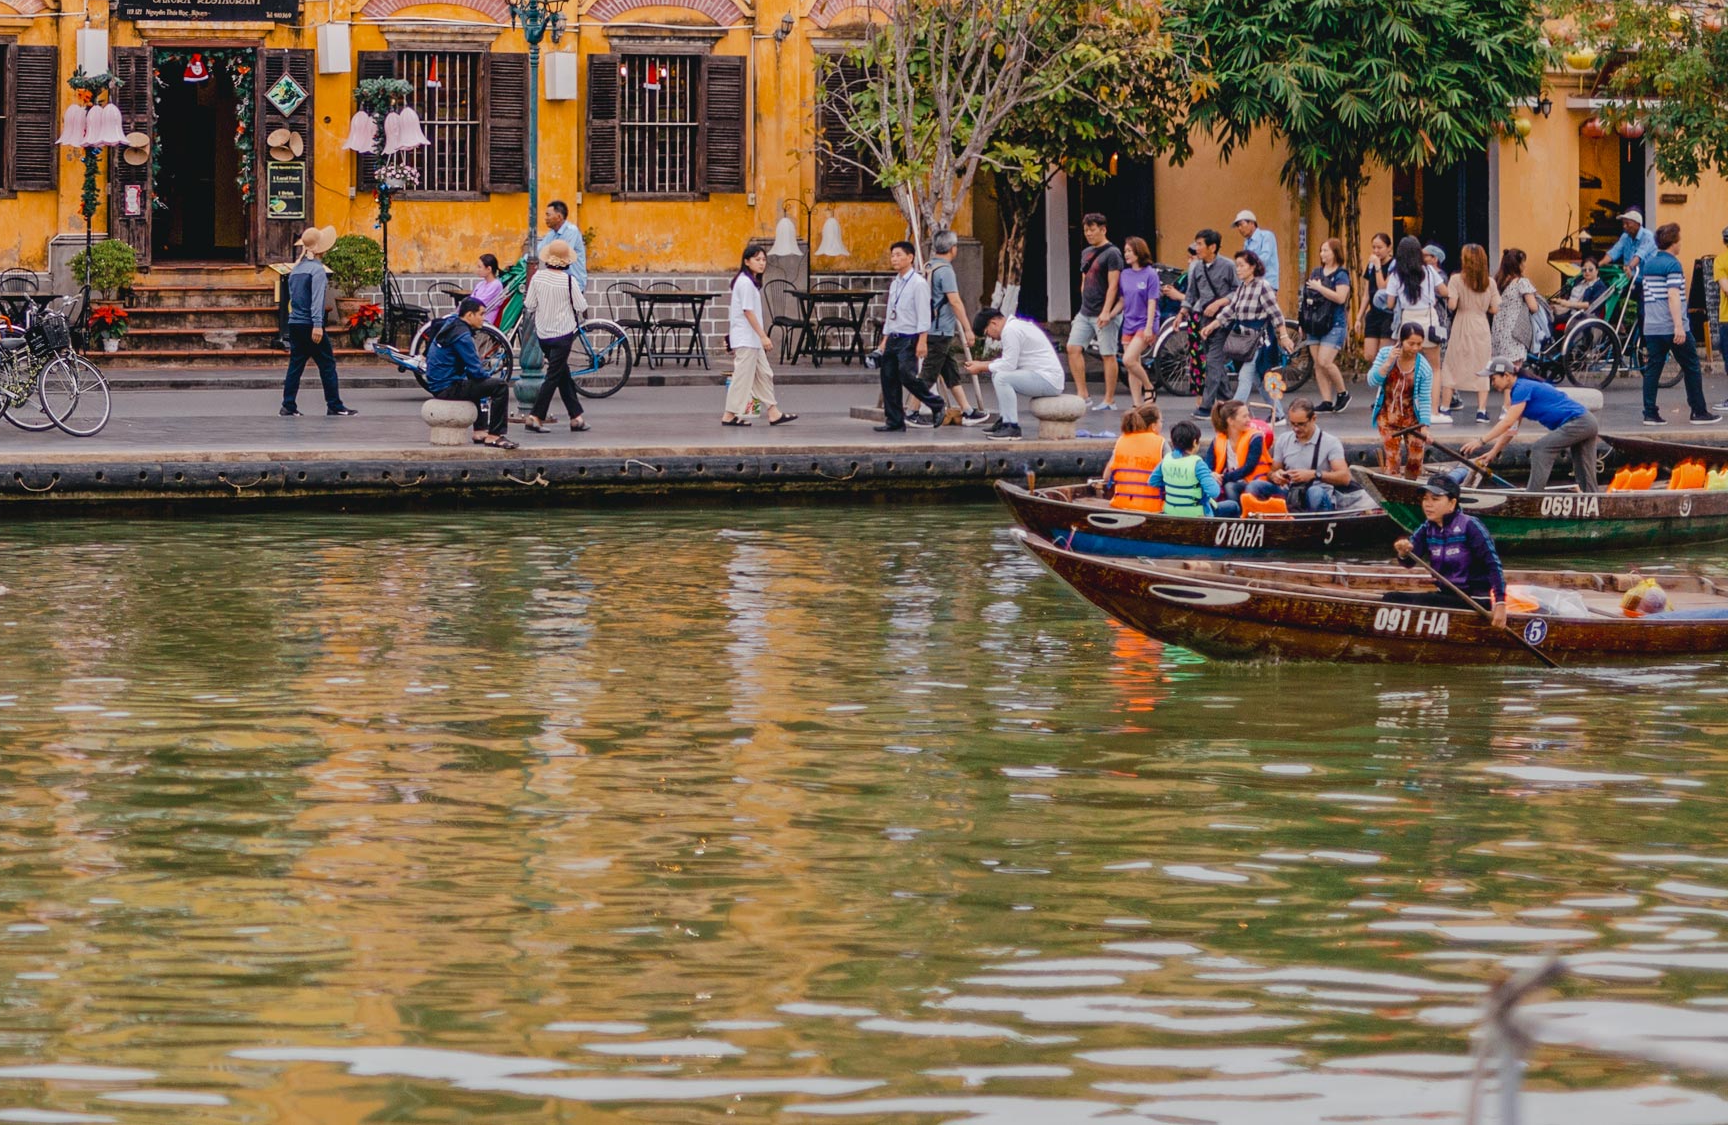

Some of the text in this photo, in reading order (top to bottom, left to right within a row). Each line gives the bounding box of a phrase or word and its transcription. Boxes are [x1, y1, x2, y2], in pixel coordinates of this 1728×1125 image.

[1540, 496, 1600, 517] 069 HA
[1323, 522, 1338, 545] 5
[1373, 607, 1450, 635] 091 HA
[1528, 621, 1543, 642] 5
